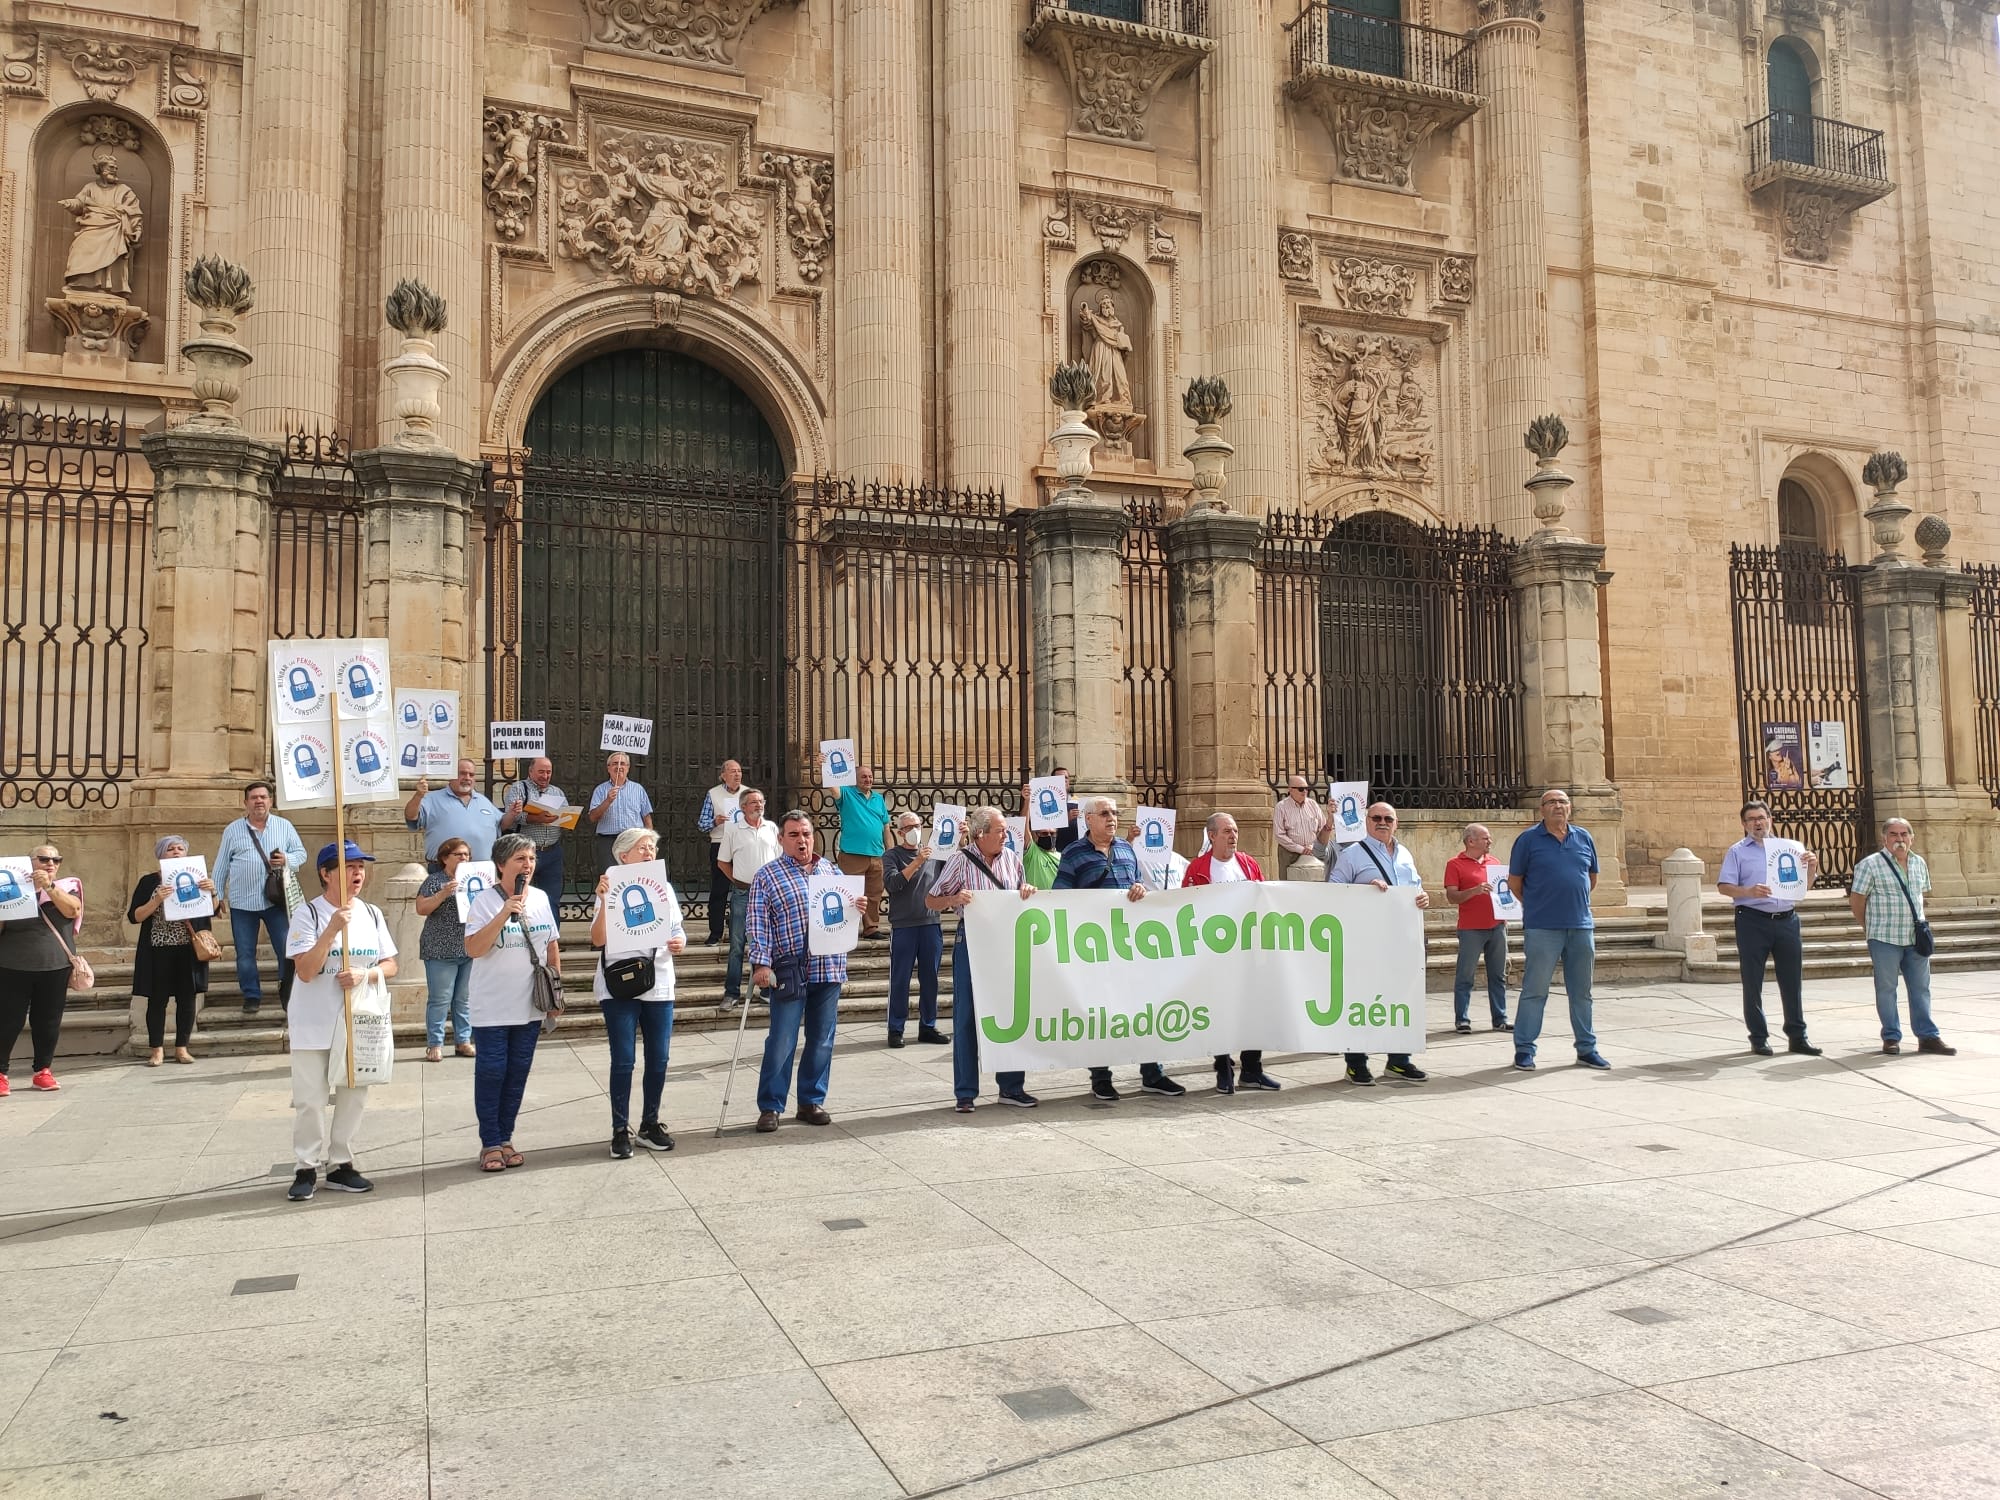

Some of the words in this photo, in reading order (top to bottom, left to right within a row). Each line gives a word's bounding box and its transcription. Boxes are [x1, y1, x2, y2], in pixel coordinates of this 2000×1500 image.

[277, 664, 289, 688] BLINDAR
[296, 657, 323, 677] PENSIONES
[337, 661, 348, 685] BLINDAR
[355, 655, 380, 675] PENSIONES
[492, 727, 522, 738] ¡PODER
[524, 727, 544, 737] GRIS
[604, 719, 624, 732] ROBAR
[633, 720, 651, 733] VIEJO
[300, 734, 328, 754] PENSIONES
[344, 737, 355, 761] BLINDAR
[362, 730, 388, 750] PENSIONES
[493, 740, 509, 750] DEL
[510, 740, 544, 750] MAYOR!
[603, 734, 610, 744] ES
[608, 881, 627, 910] BLINDAR
[637, 877, 668, 903] PENSIONES
[630, 905, 646, 916] MERP
[1015, 904, 1343, 963] Plataforma
[1305, 952, 1410, 1027] Jaén
